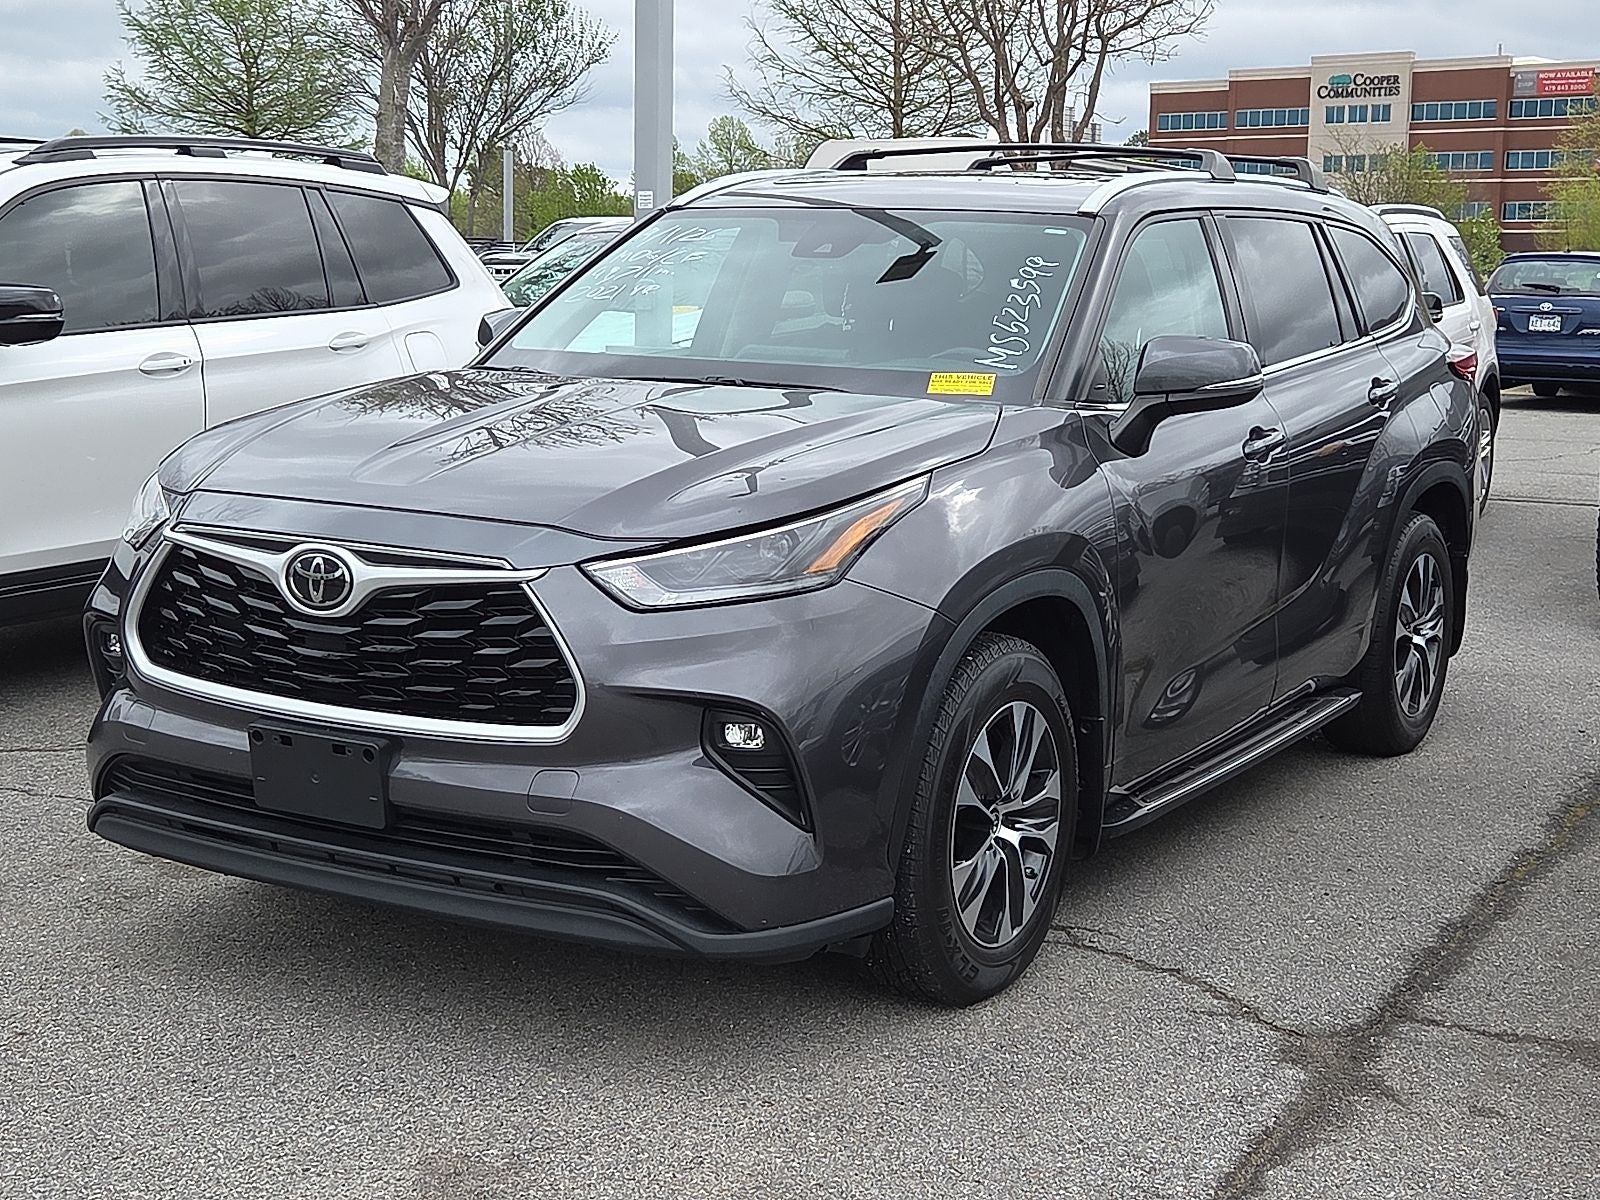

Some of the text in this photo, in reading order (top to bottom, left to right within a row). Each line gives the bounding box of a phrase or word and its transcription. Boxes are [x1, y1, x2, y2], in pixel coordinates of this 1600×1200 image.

[1353, 73, 1400, 86] COOPER
[1556, 70, 1593, 78] AVAILABLE
[1317, 85, 1400, 99] COMMUNITIES
